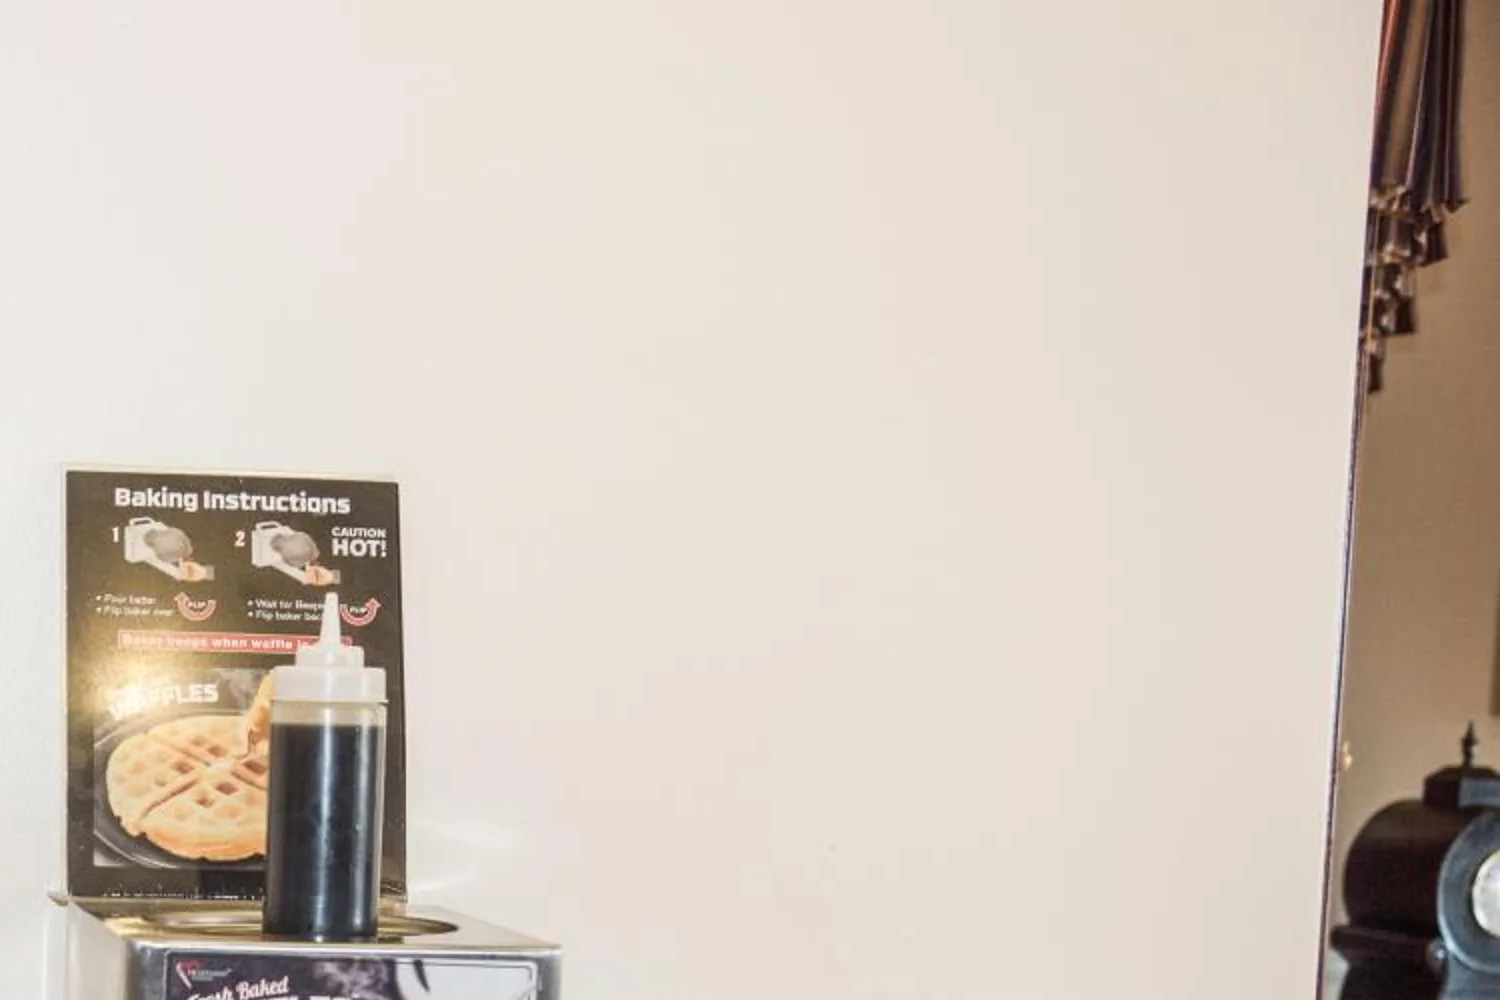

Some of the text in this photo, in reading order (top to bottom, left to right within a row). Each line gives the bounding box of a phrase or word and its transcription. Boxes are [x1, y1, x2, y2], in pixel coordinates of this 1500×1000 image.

[114, 486, 351, 515] Baking Instructions
[112, 527, 120, 543] 1
[234, 532, 245, 547] 2
[331, 526, 387, 539] CAUTION
[331, 539, 388, 558] HOT!
[212, 638, 248, 650] when
[251, 640, 293, 650] waffle
[236, 976, 289, 1000] Baked
